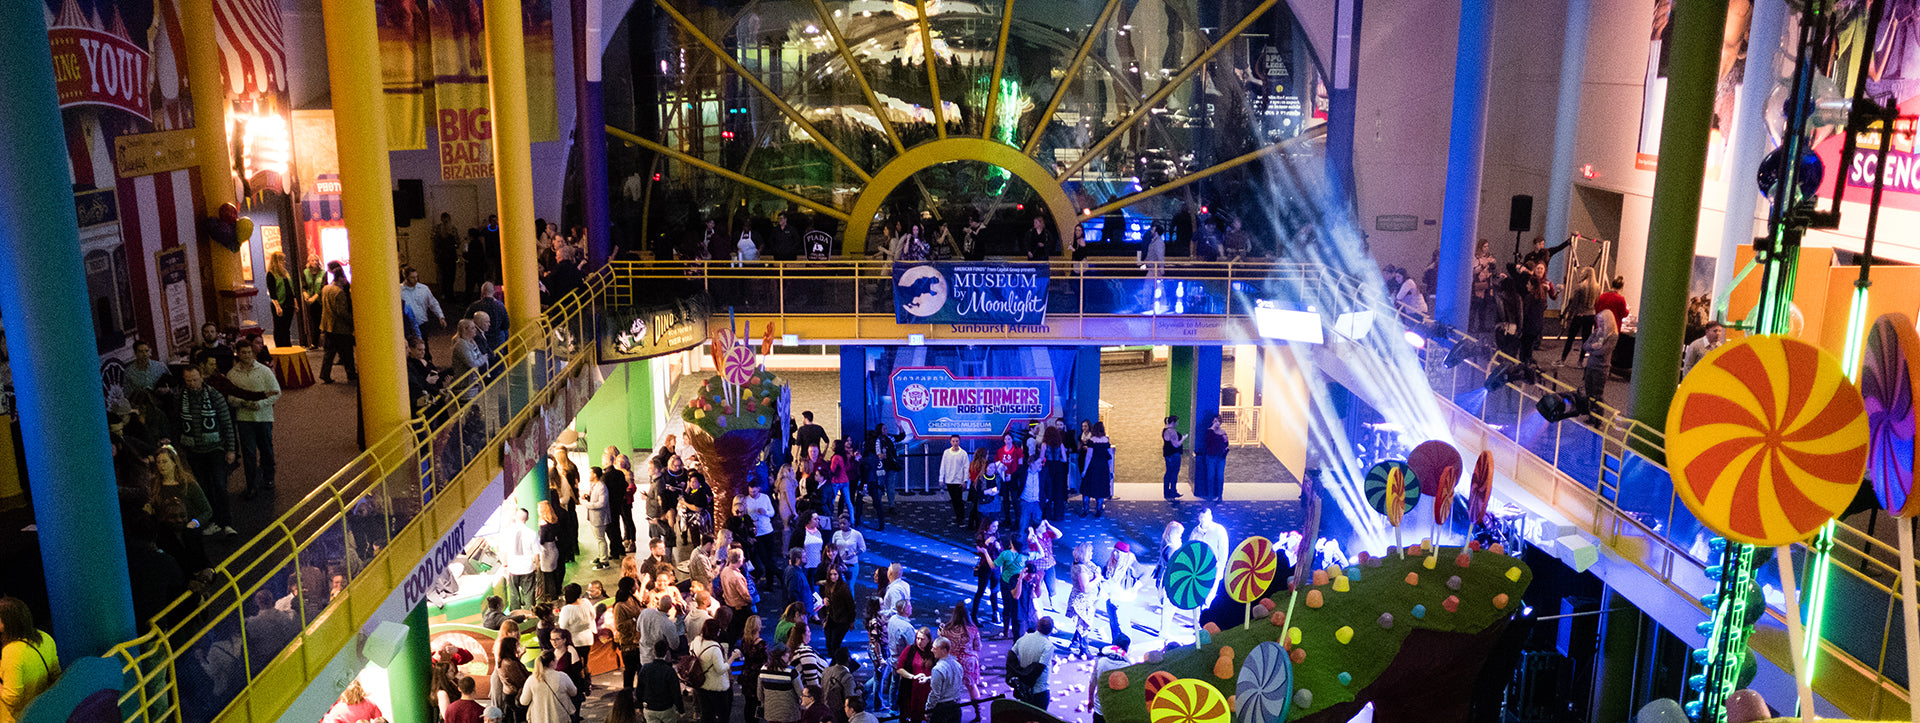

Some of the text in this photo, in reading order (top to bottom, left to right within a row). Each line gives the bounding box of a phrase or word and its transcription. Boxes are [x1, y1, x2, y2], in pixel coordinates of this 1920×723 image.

[80, 38, 143, 108] YOU!
[439, 107, 492, 142] BIG
[441, 142, 481, 164] BAD
[443, 163, 495, 179] BIZARRE
[807, 234, 828, 244] PIADA
[954, 273, 1037, 288] MUSEUM
[954, 288, 966, 300] by
[957, 290, 1046, 322] Moonlight
[952, 324, 1050, 333] Sunburst Atrium
[930, 388, 1039, 407] TRANSFORMERS
[957, 405, 993, 414] ROBOTS
[1000, 405, 1042, 414] DISGUISE
[404, 519, 465, 612] FOOD COURT
